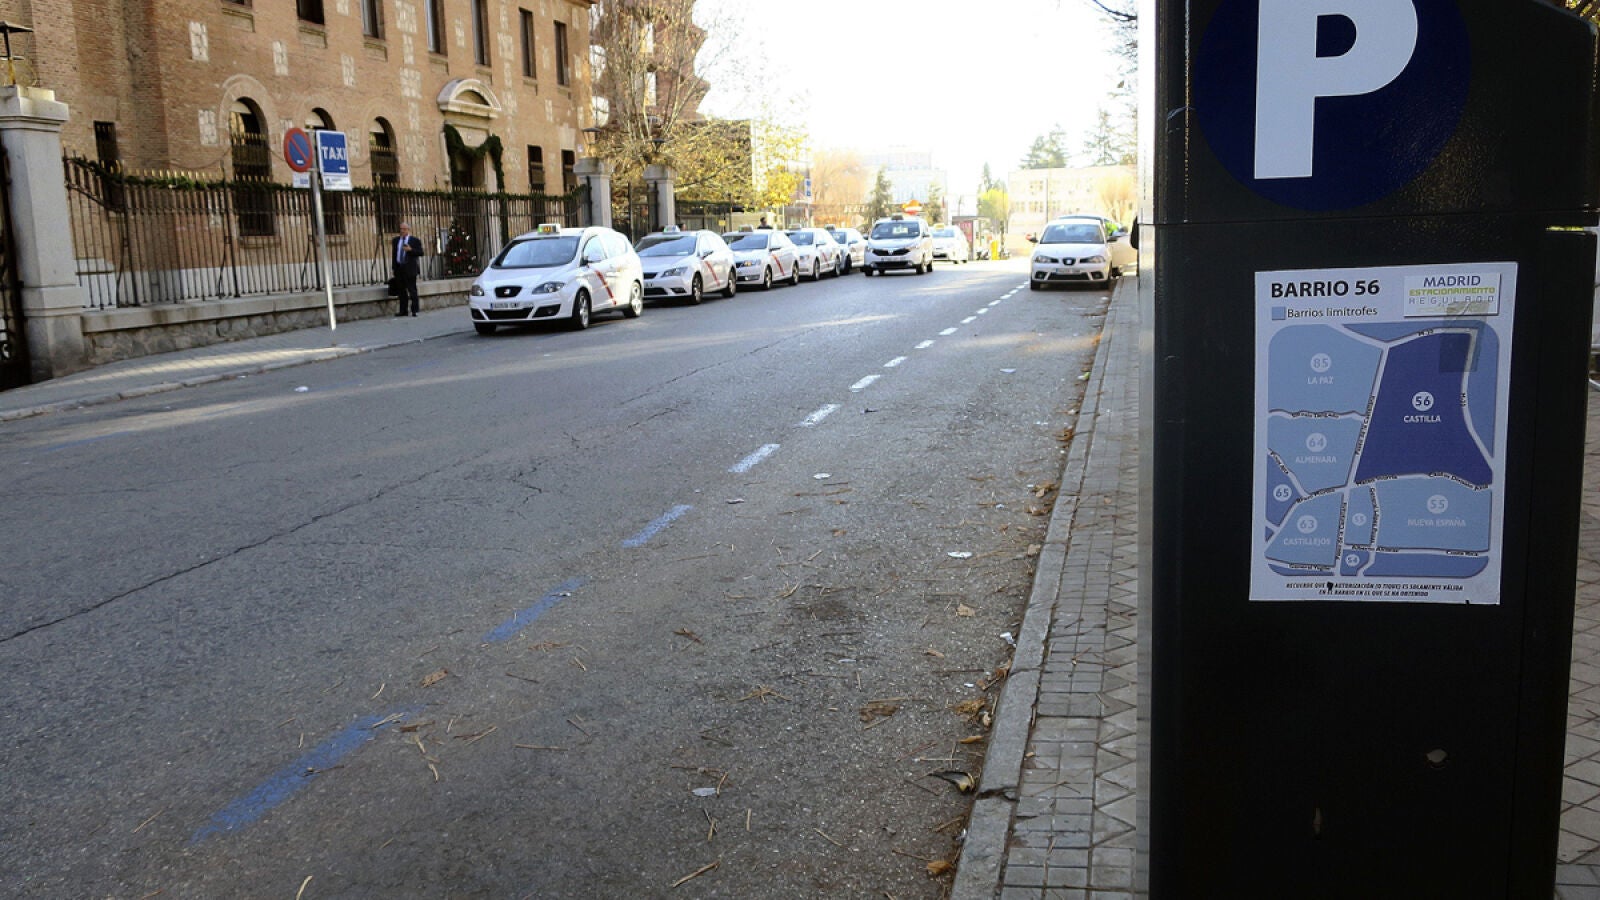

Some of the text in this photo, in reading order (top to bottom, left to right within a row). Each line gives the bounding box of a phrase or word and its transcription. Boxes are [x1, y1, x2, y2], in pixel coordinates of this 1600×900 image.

[1254, 0, 1418, 179] P
[321, 146, 346, 160] TAXI
[1423, 275, 1481, 287] MADRID
[1271, 279, 1380, 298] BARRIO 56
[1409, 287, 1495, 296] ESTACIONAMIENTO
[1287, 306, 1378, 318] Barrios limítrofes
[1313, 358, 1329, 369] 85
[1307, 376, 1334, 385] LA PAZ
[1415, 396, 1431, 406] 56
[1404, 415, 1441, 423] CASTILLA
[1308, 437, 1324, 448] 64
[1275, 488, 1289, 498] 65
[1429, 499, 1445, 509] 55
[1300, 520, 1315, 529] 63
[1408, 517, 1466, 527] NUEVA ESPAÑA
[1284, 538, 1331, 546] CASTILLEJOS
